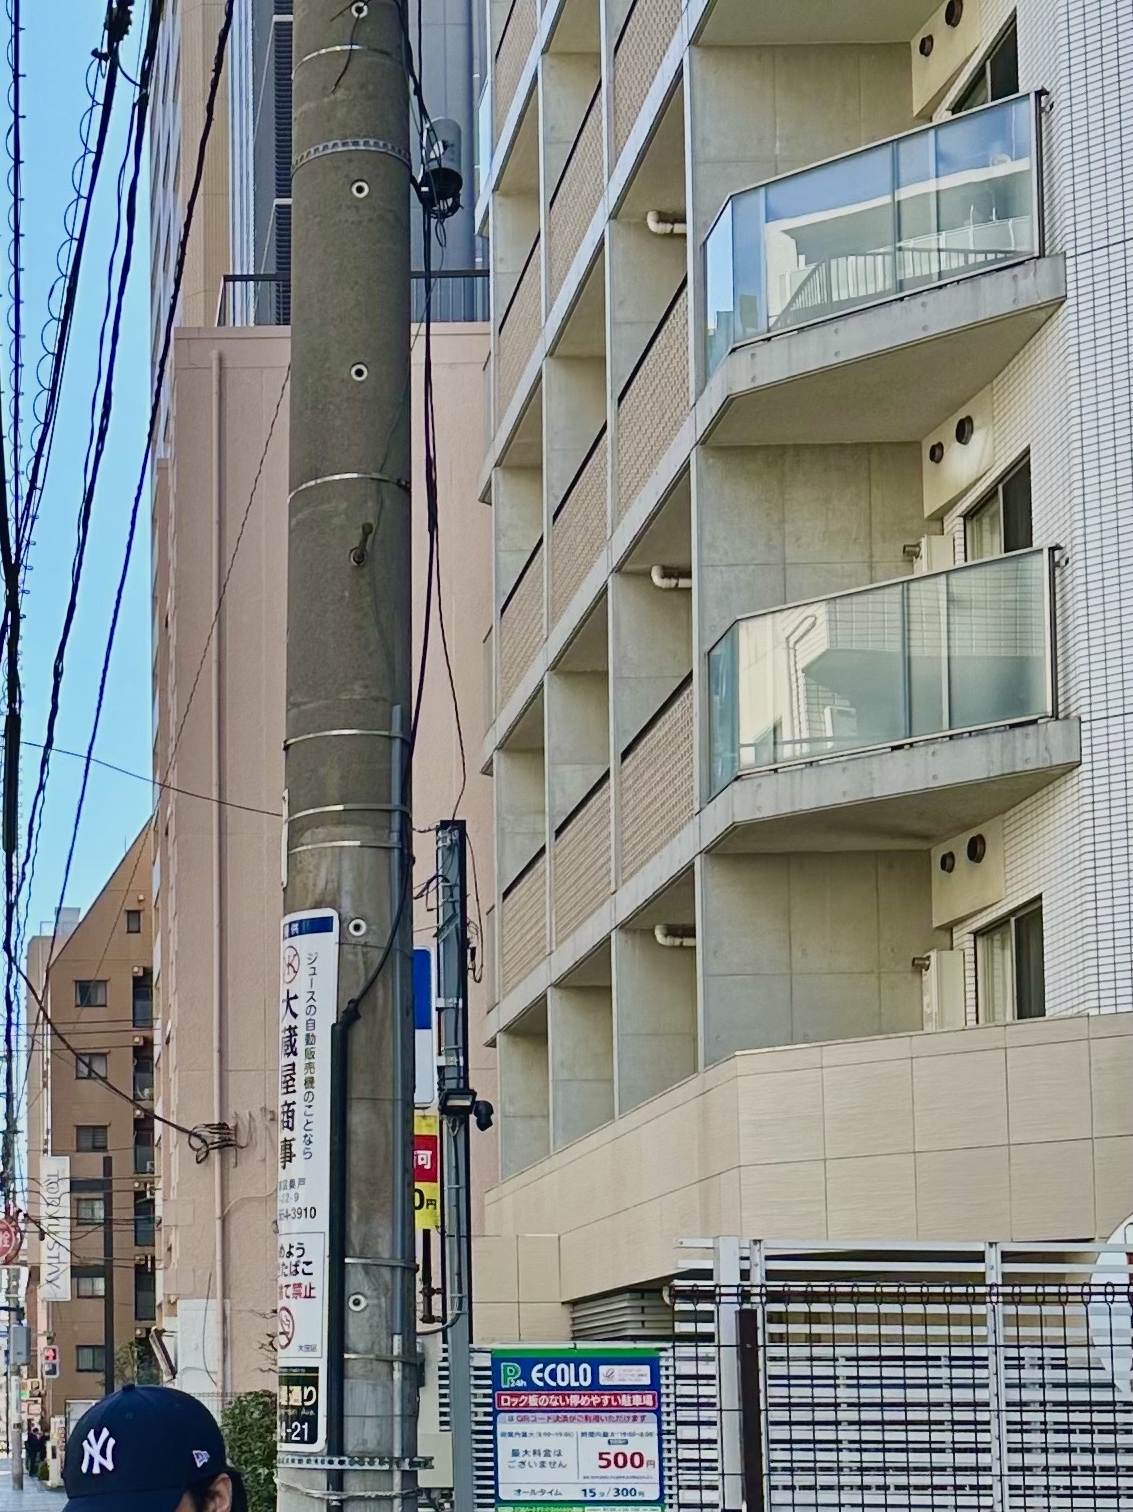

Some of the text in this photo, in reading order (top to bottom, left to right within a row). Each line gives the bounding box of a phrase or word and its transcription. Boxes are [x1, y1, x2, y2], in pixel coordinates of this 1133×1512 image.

[303, 951, 318, 1160] ジュースの自動販売機のことなら
[530, 1362, 593, 1387] ECOLO
[81, 1427, 116, 1474] NY
[511, 1448, 564, 1459] 最大料金は
[507, 1459, 568, 1470] ございません
[513, 1488, 563, 1497] オールタイム
